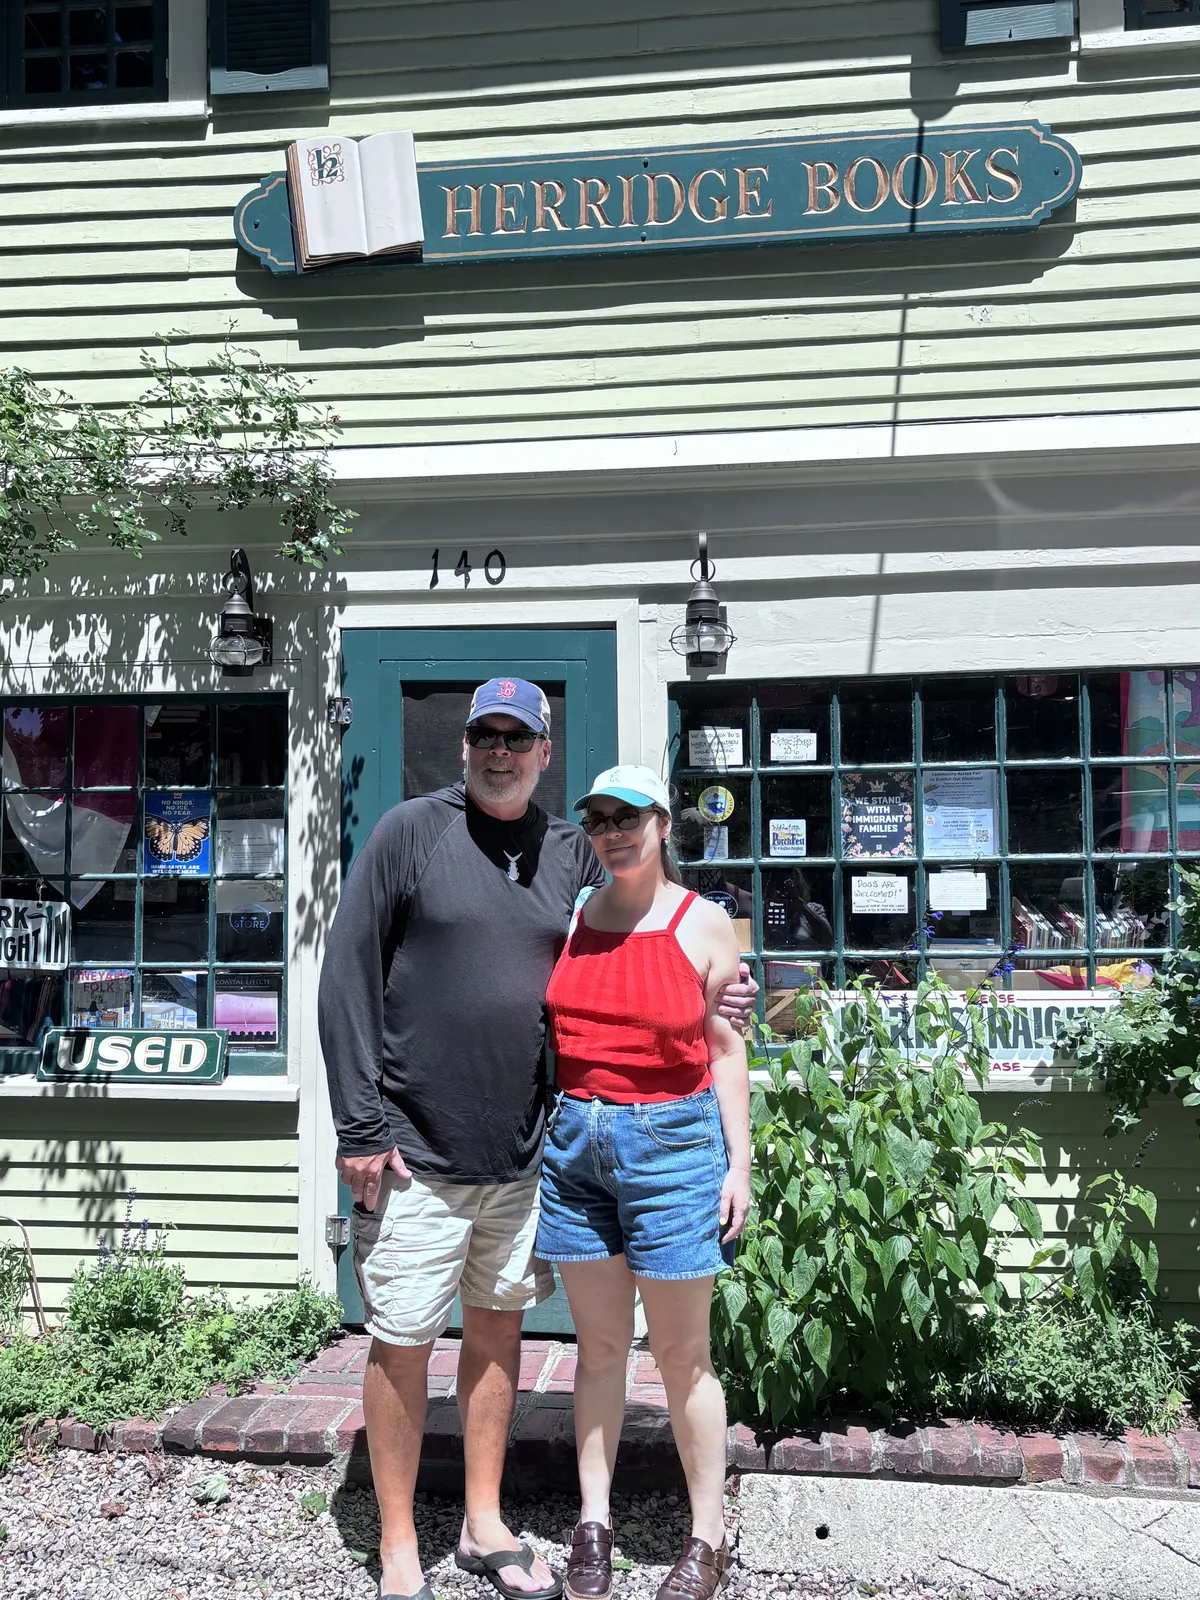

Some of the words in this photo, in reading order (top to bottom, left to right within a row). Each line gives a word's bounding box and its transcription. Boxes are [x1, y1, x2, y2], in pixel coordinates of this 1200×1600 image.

[437, 164, 773, 239] HERRIDGE
[800, 145, 1023, 216] BOOKS
[429, 548, 506, 590] 140
[496, 680, 516, 698] B
[855, 796, 870, 804] WE
[872, 796, 902, 804] STAND
[866, 805, 890, 814] WITH
[852, 814, 904, 823] IMMIGRANT
[859, 824, 898, 833] FAMILIES
[857, 879, 878, 888] DOGS
[882, 880, 898, 888] ARE
[234, 920, 265, 928] STORE
[45, 906, 67, 964] IN
[84, 982, 114, 993] FOLK
[960, 994, 1015, 1004] PESE
[946, 1006, 1106, 1050] SRAIG
[56, 1036, 208, 1073] USED
[962, 1062, 1021, 1072] PASE
